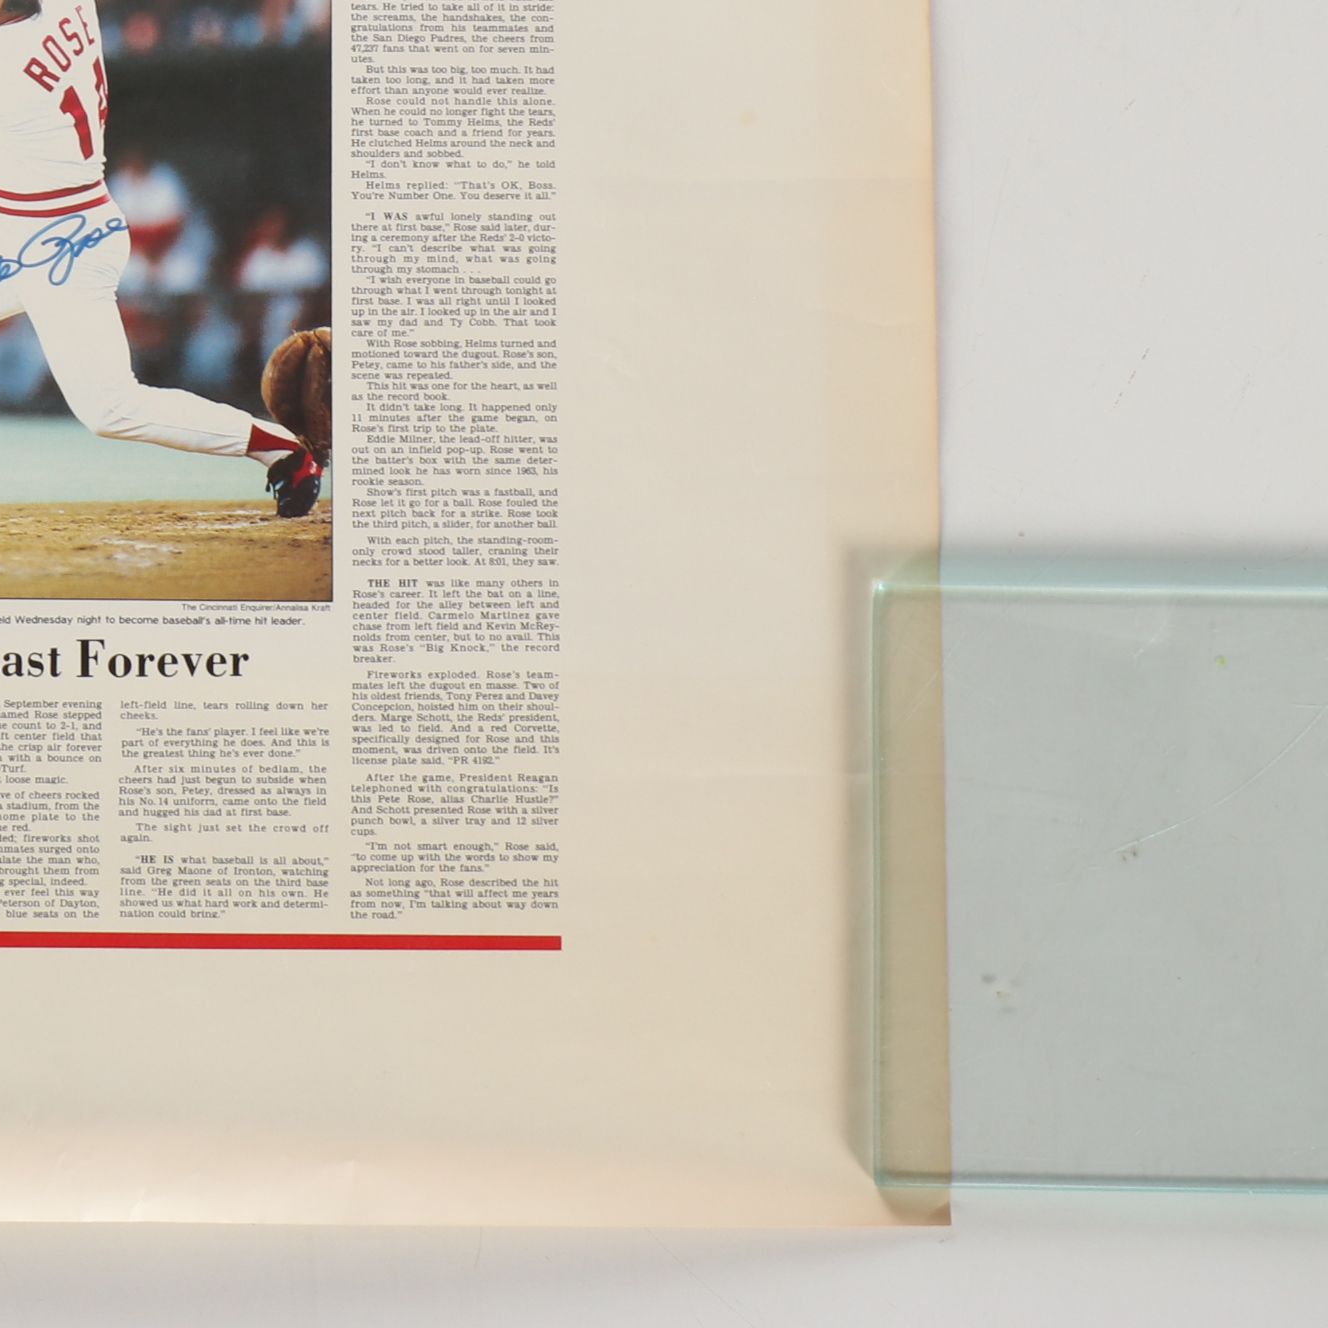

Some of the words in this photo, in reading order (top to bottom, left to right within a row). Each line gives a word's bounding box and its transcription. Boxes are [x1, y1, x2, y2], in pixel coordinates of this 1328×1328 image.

[367, 578, 391, 588] THE
[398, 578, 419, 588] HIT
[14, 615, 74, 626] Wednesday
[76, 615, 102, 627] night
[104, 615, 116, 625] to
[118, 615, 160, 625] become
[162, 615, 212, 626] baseball's
[214, 615, 252, 626] all-time
[254, 616, 268, 626] hit
[270, 616, 305, 626] leader.
[76, 638, 250, 679] Forever
